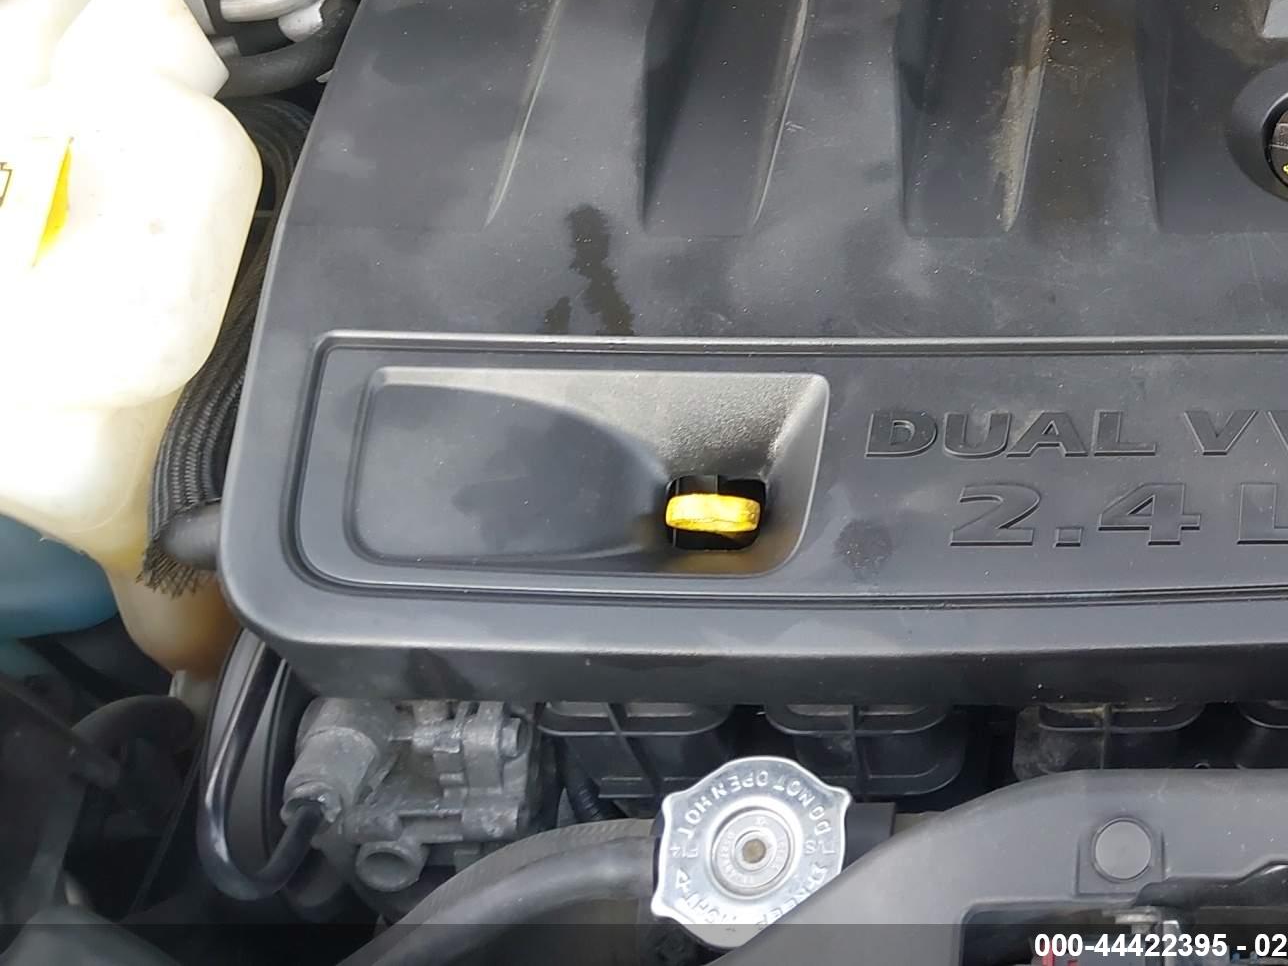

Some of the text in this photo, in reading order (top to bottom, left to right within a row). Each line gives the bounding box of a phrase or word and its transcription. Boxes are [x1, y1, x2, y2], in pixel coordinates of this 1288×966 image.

[864, 409, 1158, 460] DUAL
[676, 770, 832, 840] DO NOT OPEN HOT
